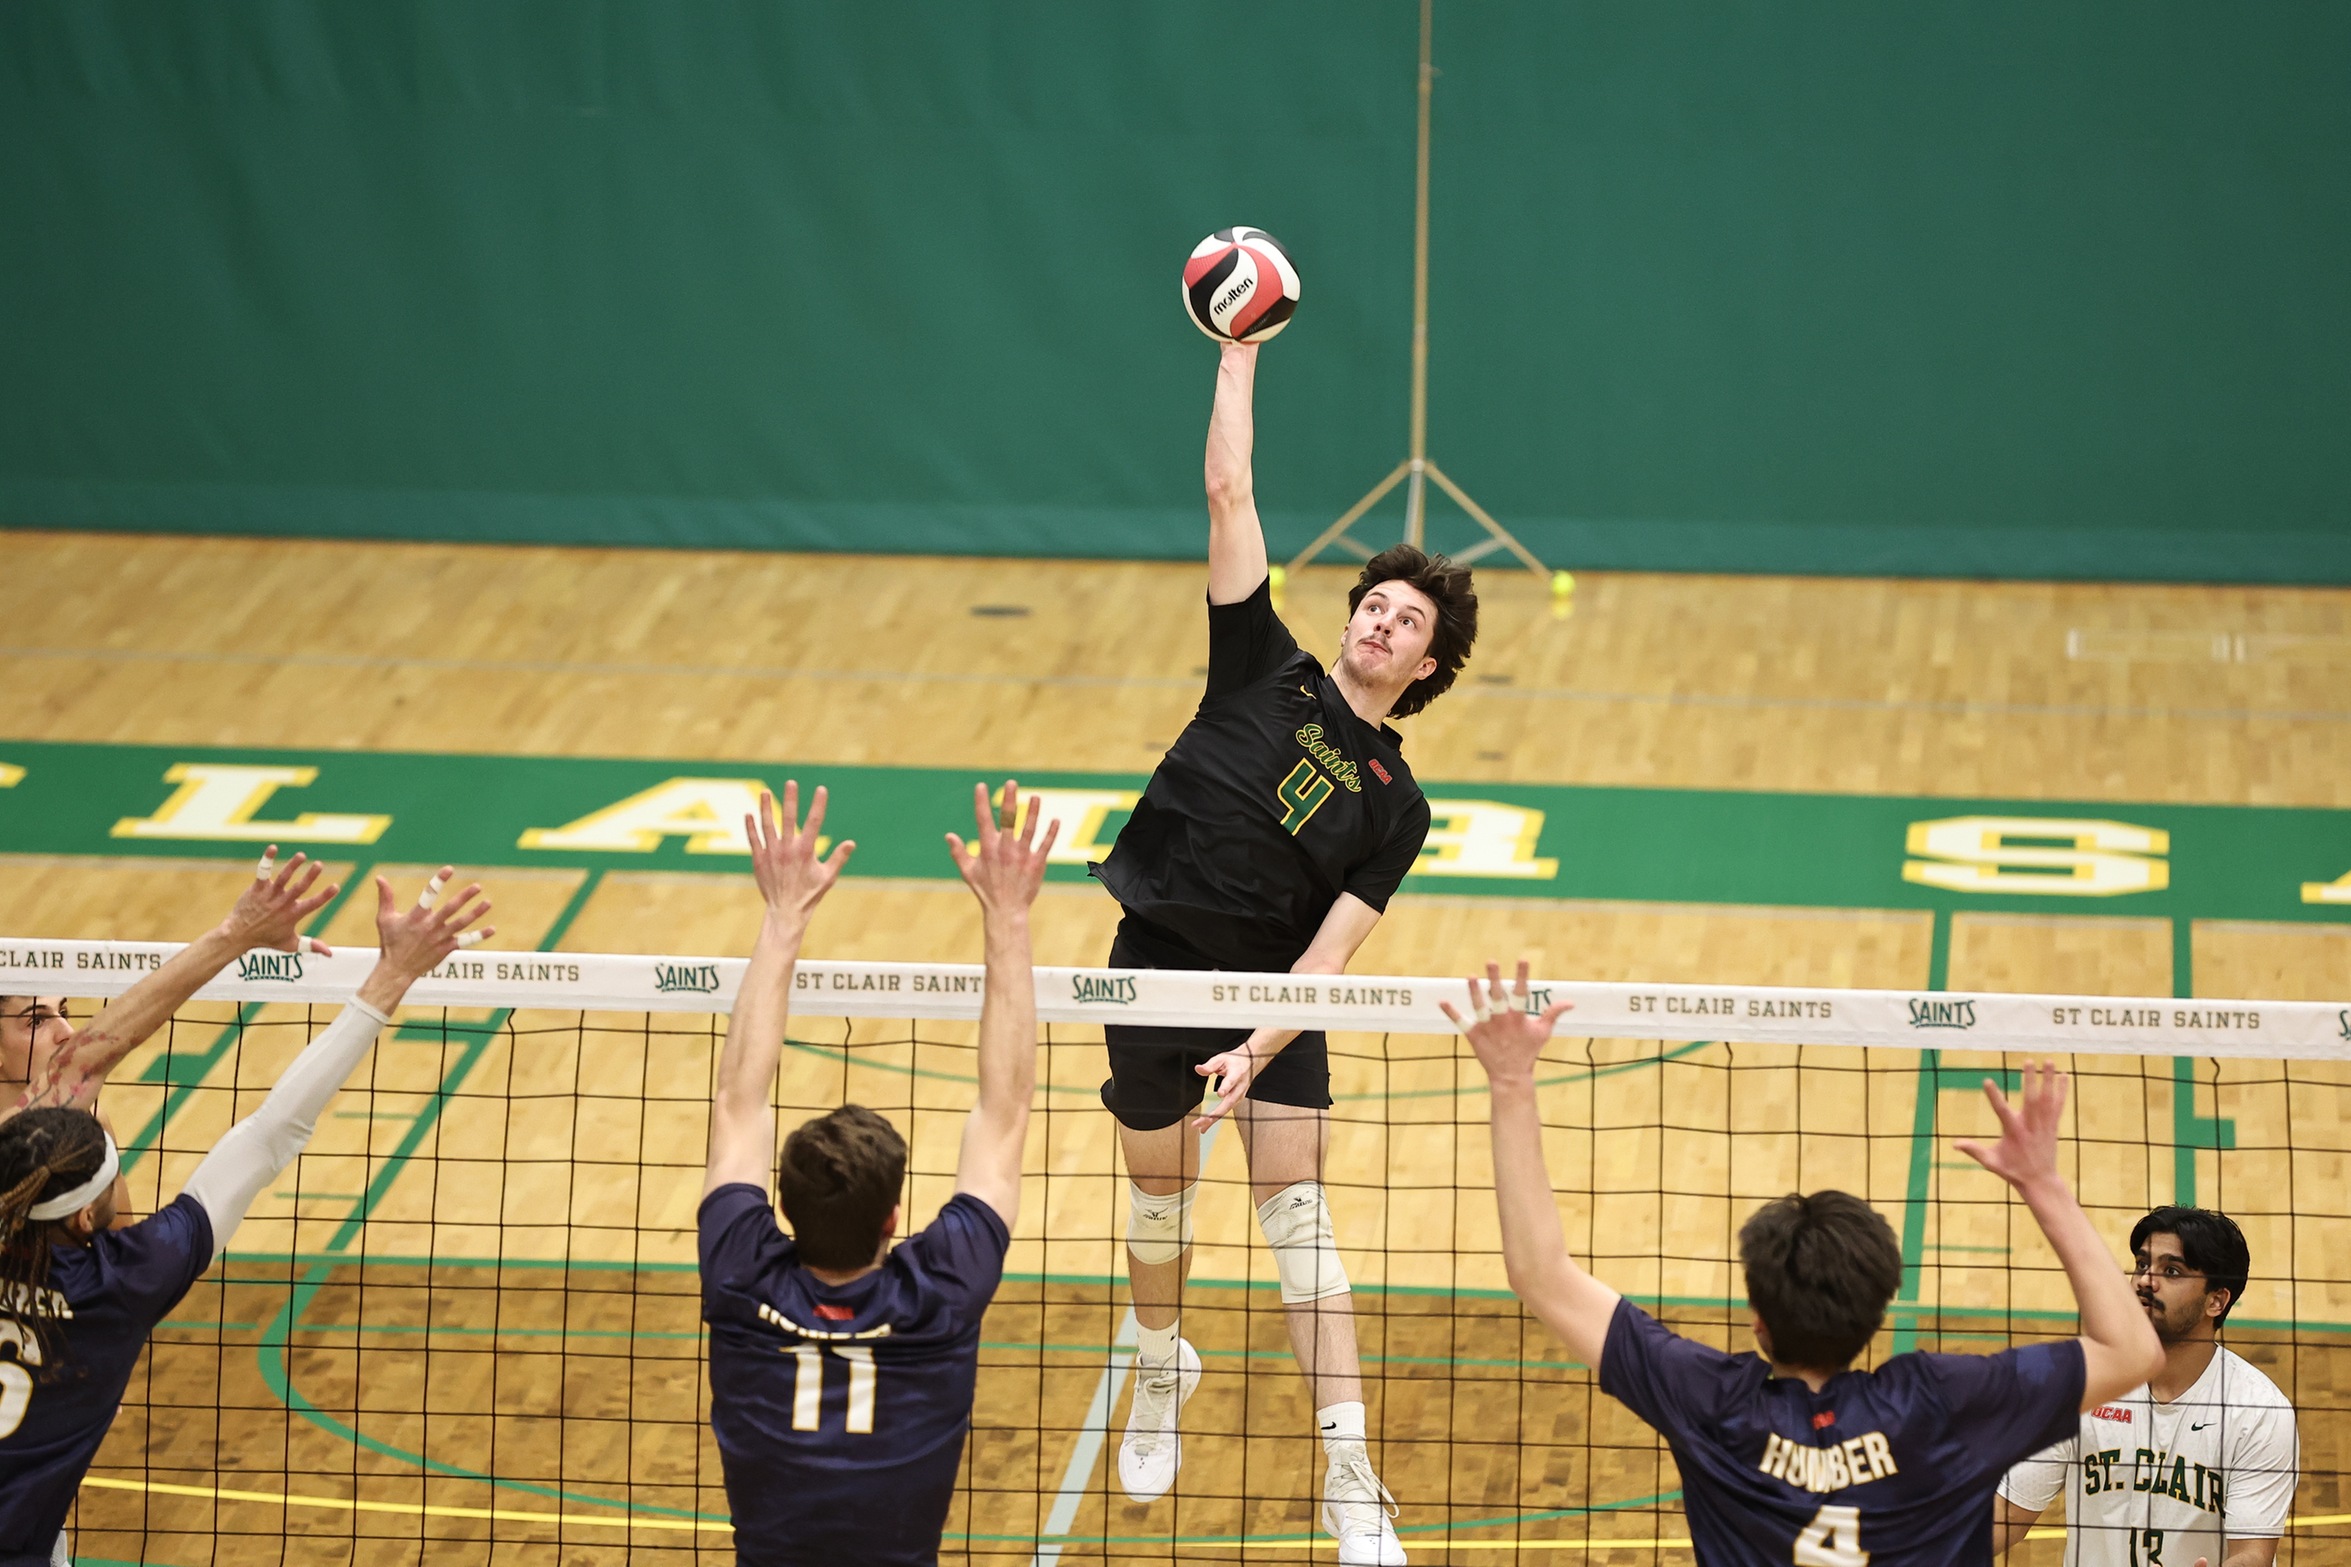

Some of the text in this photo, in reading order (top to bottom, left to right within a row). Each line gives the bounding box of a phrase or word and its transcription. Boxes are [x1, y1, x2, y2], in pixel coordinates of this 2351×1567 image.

[1213, 277, 1254, 315] molten
[1296, 723, 1362, 793] Saints
[1277, 757, 1335, 836] 4
[77, 952, 161, 970] SAINTS
[237, 952, 303, 979] SAINTS
[420, 962, 580, 982] LAIR SAINTS
[654, 963, 719, 990] SAINTS
[796, 973, 982, 993] ST CLAIR SAINT
[1072, 974, 1137, 1002] SAINTS
[1212, 986, 1412, 1006] ST CLAIR SAINTS
[1629, 996, 1832, 1018] ST CLAIR SAINTS
[1909, 998, 1975, 1027] SAINTS
[2053, 1008, 2260, 1029] ST CLAIR SAINTS
[778, 1344, 877, 1434] 11
[1758, 1431, 1899, 1494] HUMBER
[2084, 1448, 2226, 1519] ST. CLAIR
[1793, 1504, 1870, 1567] 4
